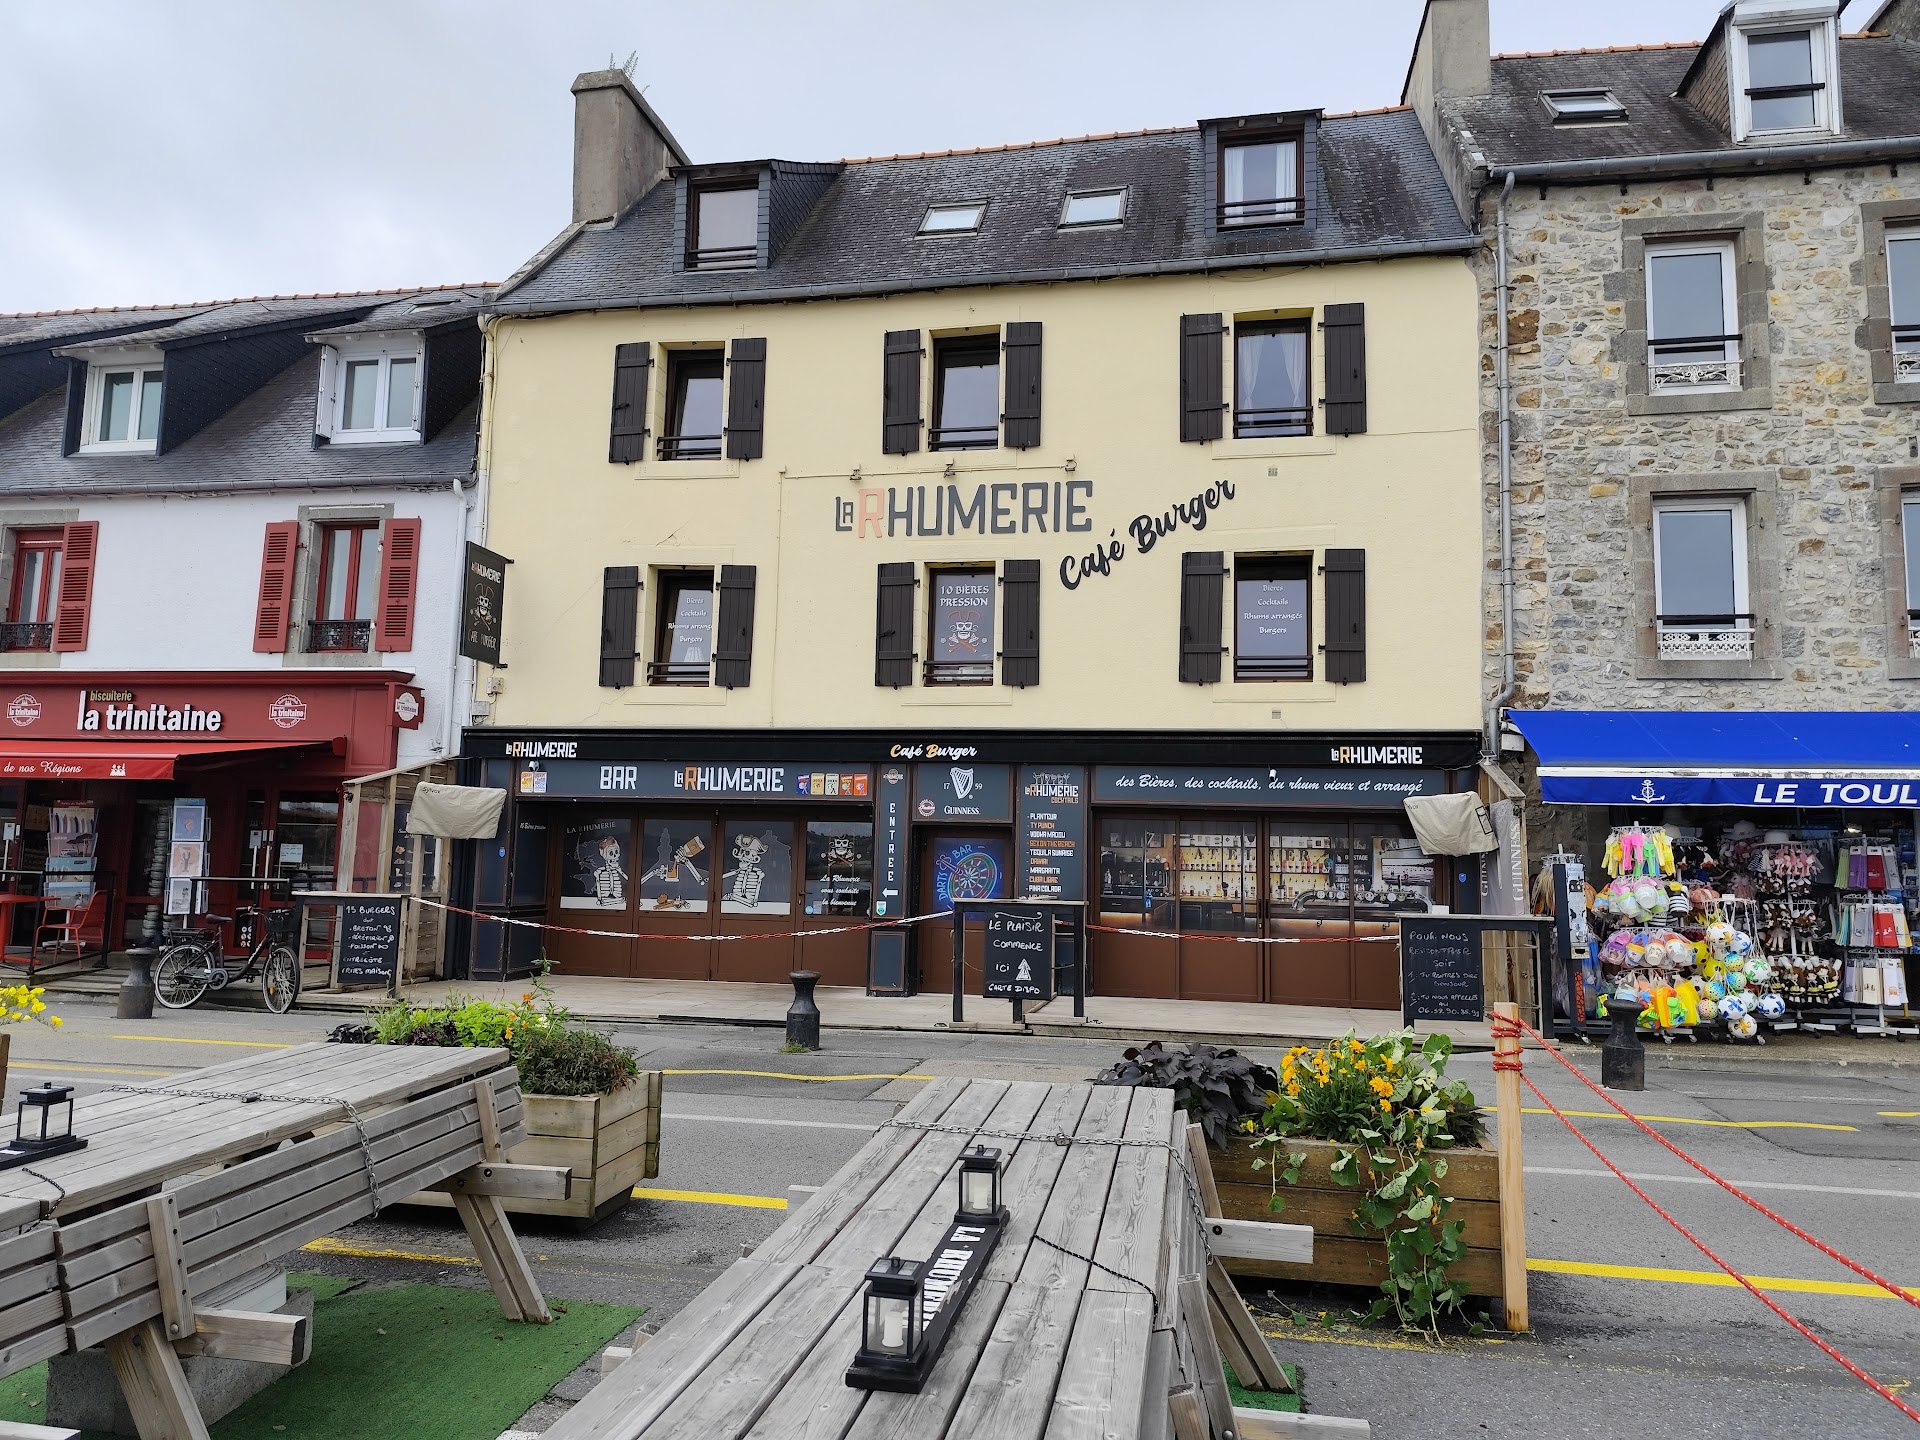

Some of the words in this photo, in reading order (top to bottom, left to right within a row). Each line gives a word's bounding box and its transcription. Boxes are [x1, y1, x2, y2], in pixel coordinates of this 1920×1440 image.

[835, 496, 854, 532] LA
[858, 480, 1093, 538] RHUMERIE
[1060, 528, 1125, 591] Café
[1128, 480, 1236, 554] Burger
[940, 585, 954, 595] 10
[955, 583, 990, 595] BIÈRES
[940, 597, 988, 607] PRESSION
[1257, 597, 1289, 606] Cocktails
[680, 609, 708, 617] Cocktails
[1243, 612, 1270, 620] Rhums
[1270, 612, 1303, 621] arrangés
[667, 622, 690, 630] Rhums
[1259, 626, 1287, 635] Burgers
[679, 635, 703, 644] Burgers
[90, 690, 133, 702] biscuiterie
[15, 707, 39, 717] trinitaine
[77, 690, 100, 731] la
[106, 703, 222, 732] trinitaine
[278, 708, 304, 717] trinitaine
[512, 741, 578, 758] RHUMERIE
[890, 743, 923, 760] Café
[925, 743, 978, 761] Burger
[1339, 746, 1423, 764] RHUMERIE
[4, 761, 15, 773] de
[18, 764, 36, 773] nos
[40, 760, 83, 777] Régions
[600, 765, 638, 790] BAR
[674, 769, 684, 788] LA
[684, 766, 784, 792] RHUMERIE
[943, 782, 950, 790] 17
[1030, 785, 1079, 797] RHUMERIE
[1115, 775, 1135, 788] des
[1138, 773, 1178, 789] Bières,
[1184, 776, 1204, 789] des
[1208, 775, 1262, 791] cocktails,
[1268, 776, 1286, 790] du
[1288, 777, 1320, 791] rhum
[1323, 779, 1355, 792] vieux
[1357, 779, 1371, 791] et
[1373, 778, 1424, 799] arrangé
[1753, 783, 1799, 803] LE
[1819, 783, 1918, 805] TOUL
[1051, 796, 1079, 804] COCKTAILS
[943, 805, 980, 815] GUINNESS
[1029, 813, 1058, 821] PLANTEUR
[578, 821, 617, 833] RHUMERIE
[1038, 822, 1055, 830] PUNCH
[887, 802, 896, 882] ENTREE
[951, 844, 973, 859] BAR
[1029, 848, 1052, 856] TEQUILA
[1051, 849, 1074, 857] SUNRISE
[1510, 818, 1524, 902] GUINNESS
[1029, 866, 1061, 874] MARGARITA
[820, 873, 831, 882] La
[832, 874, 861, 882] Rhumerie
[1043, 876, 1059, 884] LIBRE
[835, 886, 860, 895] souhaite
[936, 871, 948, 902] DARTS
[1041, 885, 1062, 893] COLADA
[829, 898, 858, 906] bienvenue
[359, 905, 396, 916] BURGERS
[988, 919, 1001, 930] LE
[1006, 918, 1045, 932] PLAISIR
[1441, 932, 1469, 942] NOUS
[993, 939, 1043, 952] COMMENCE
[988, 983, 1012, 992] CARTE
[950, 1225, 986, 1242] LA
